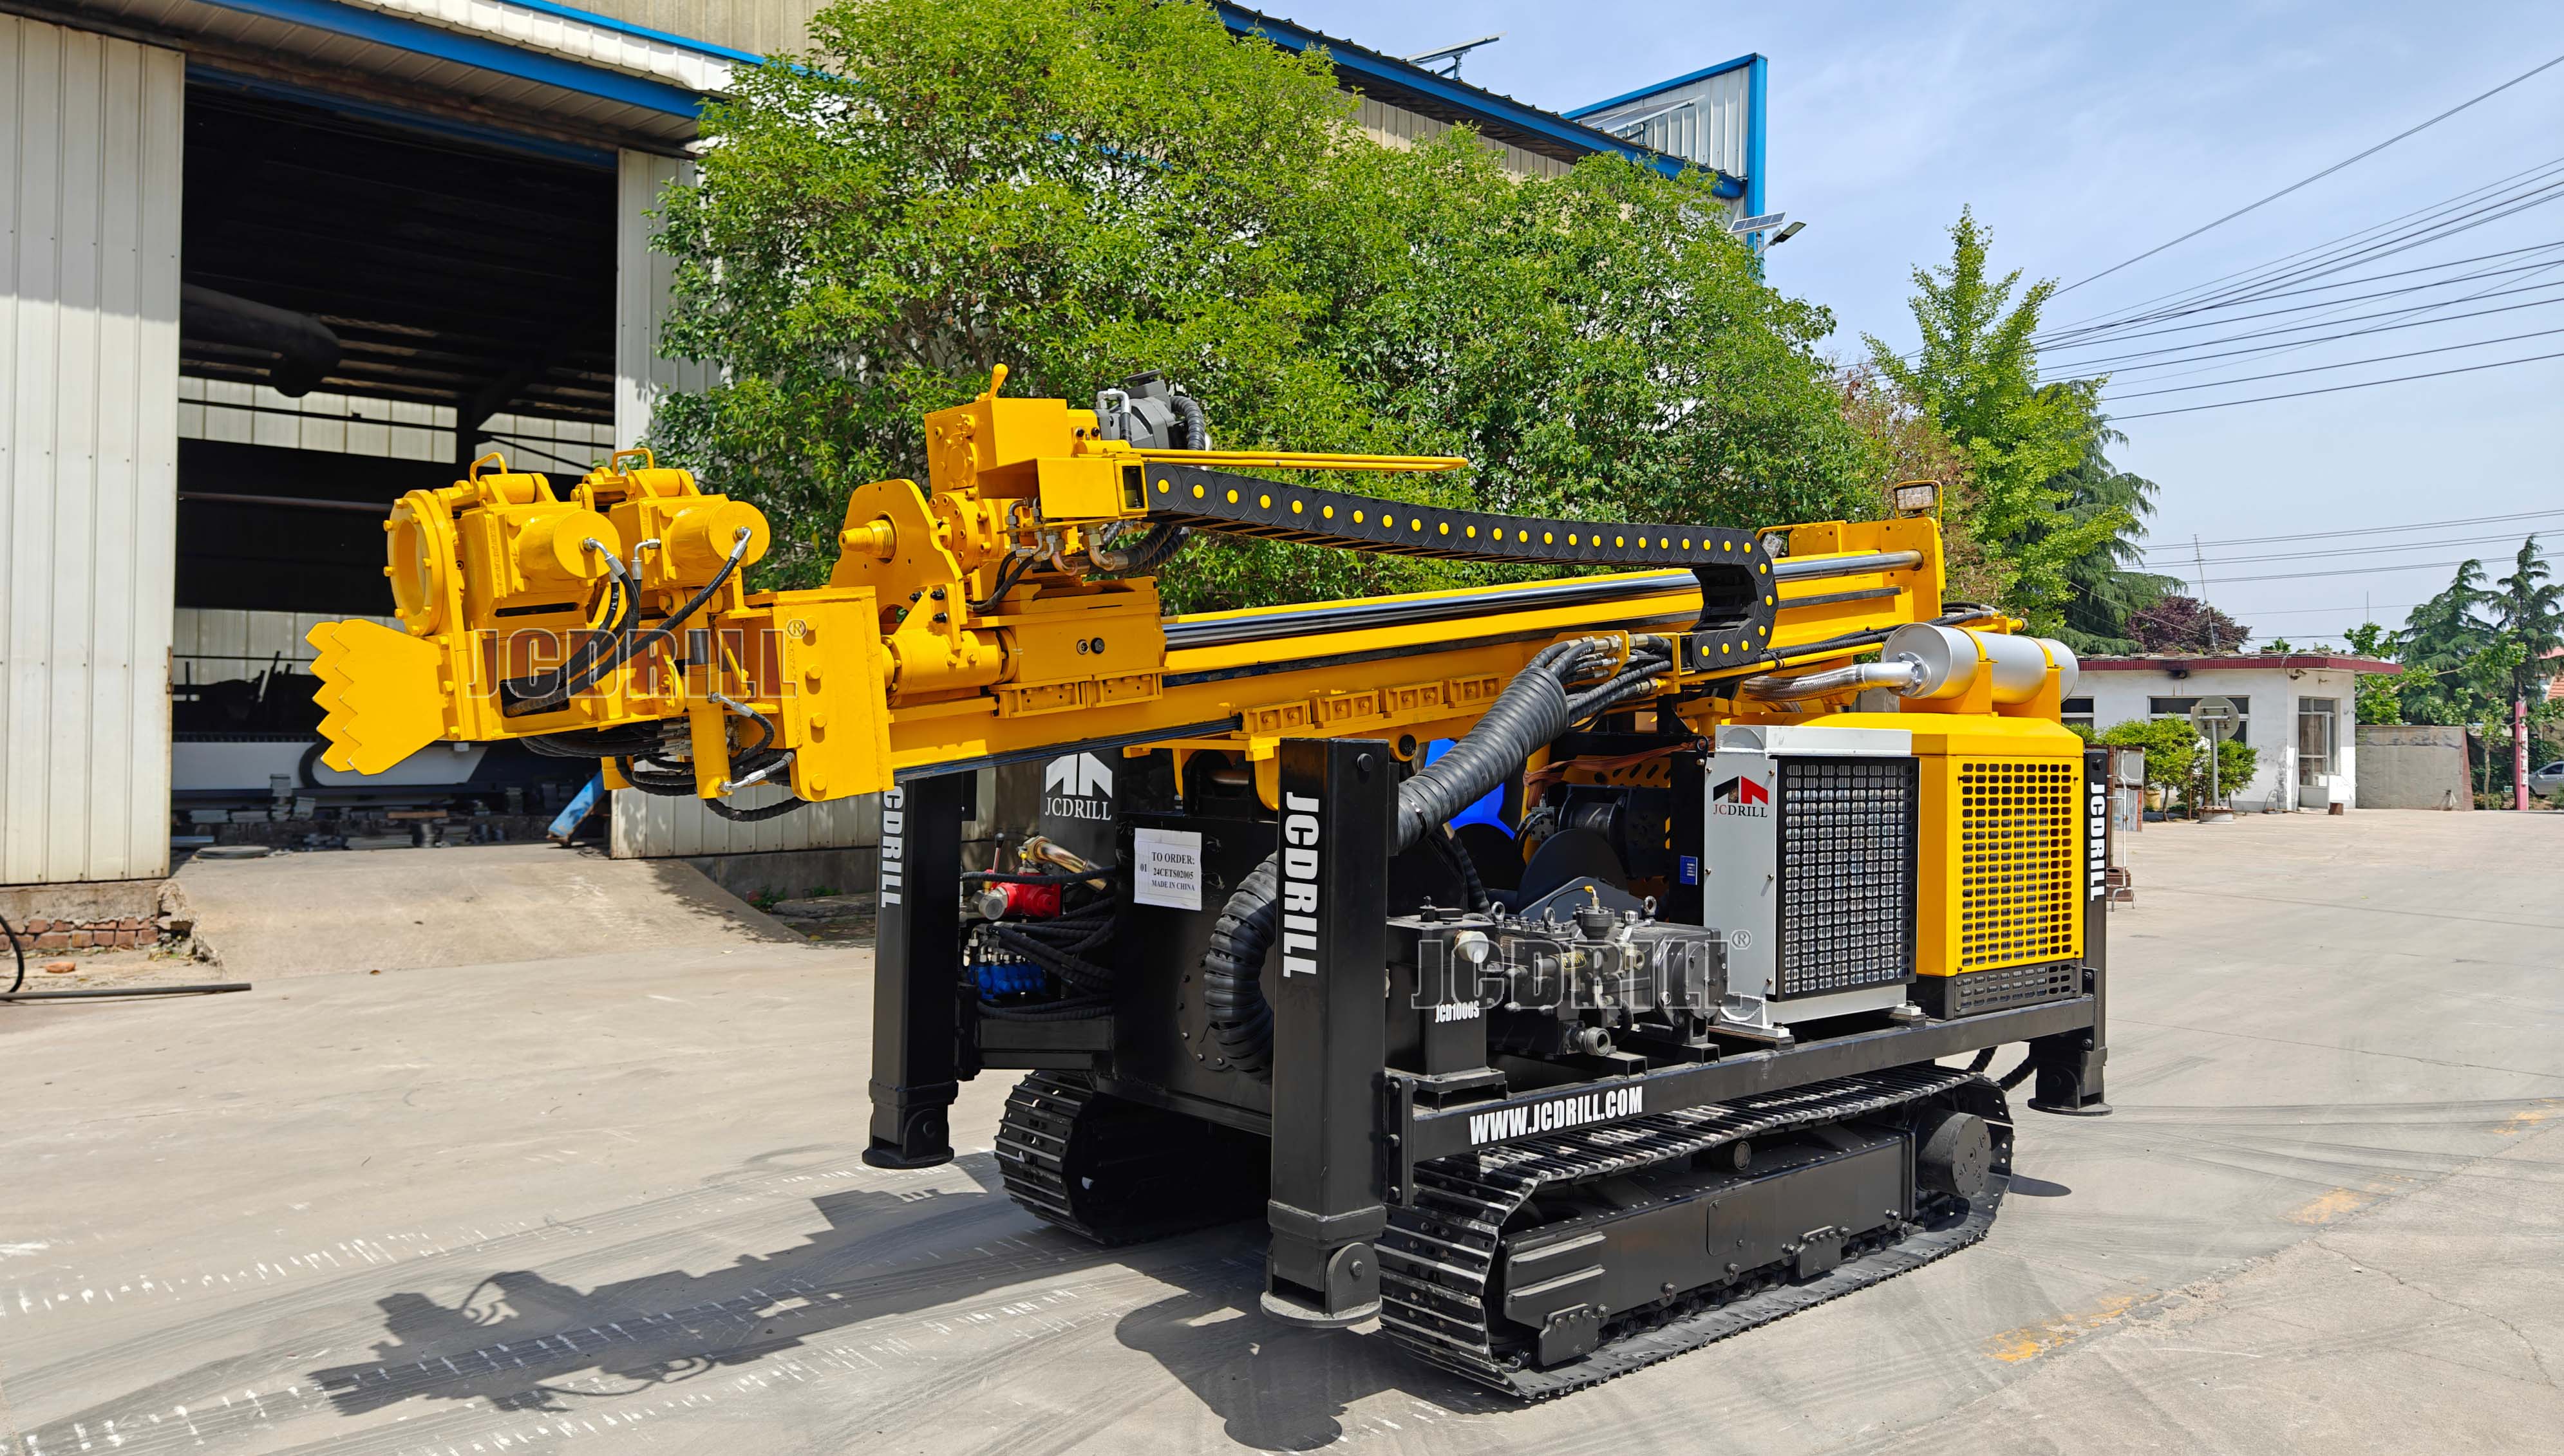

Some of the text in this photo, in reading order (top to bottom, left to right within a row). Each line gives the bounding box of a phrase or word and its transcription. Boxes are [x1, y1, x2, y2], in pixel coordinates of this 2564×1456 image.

[1044, 797, 1112, 821] JCDRILL
[1713, 804, 1767, 818] JCDRILL
[881, 781, 904, 908] CDRILL
[2090, 782, 2106, 901] JCDRILL
[1140, 863, 1147, 872] 01
[1151, 852, 1195, 865] TO ORDER:
[1153, 867, 1194, 880] 24CETS02005
[1283, 792, 1319, 978] JCDRILL
[1151, 880, 1169, 888] MADE
[1176, 882, 1195, 891] CHINA
[1435, 1000, 1480, 1023] JCD1000S
[1469, 1086, 1643, 1146] WWW.JCDRILL.COM
